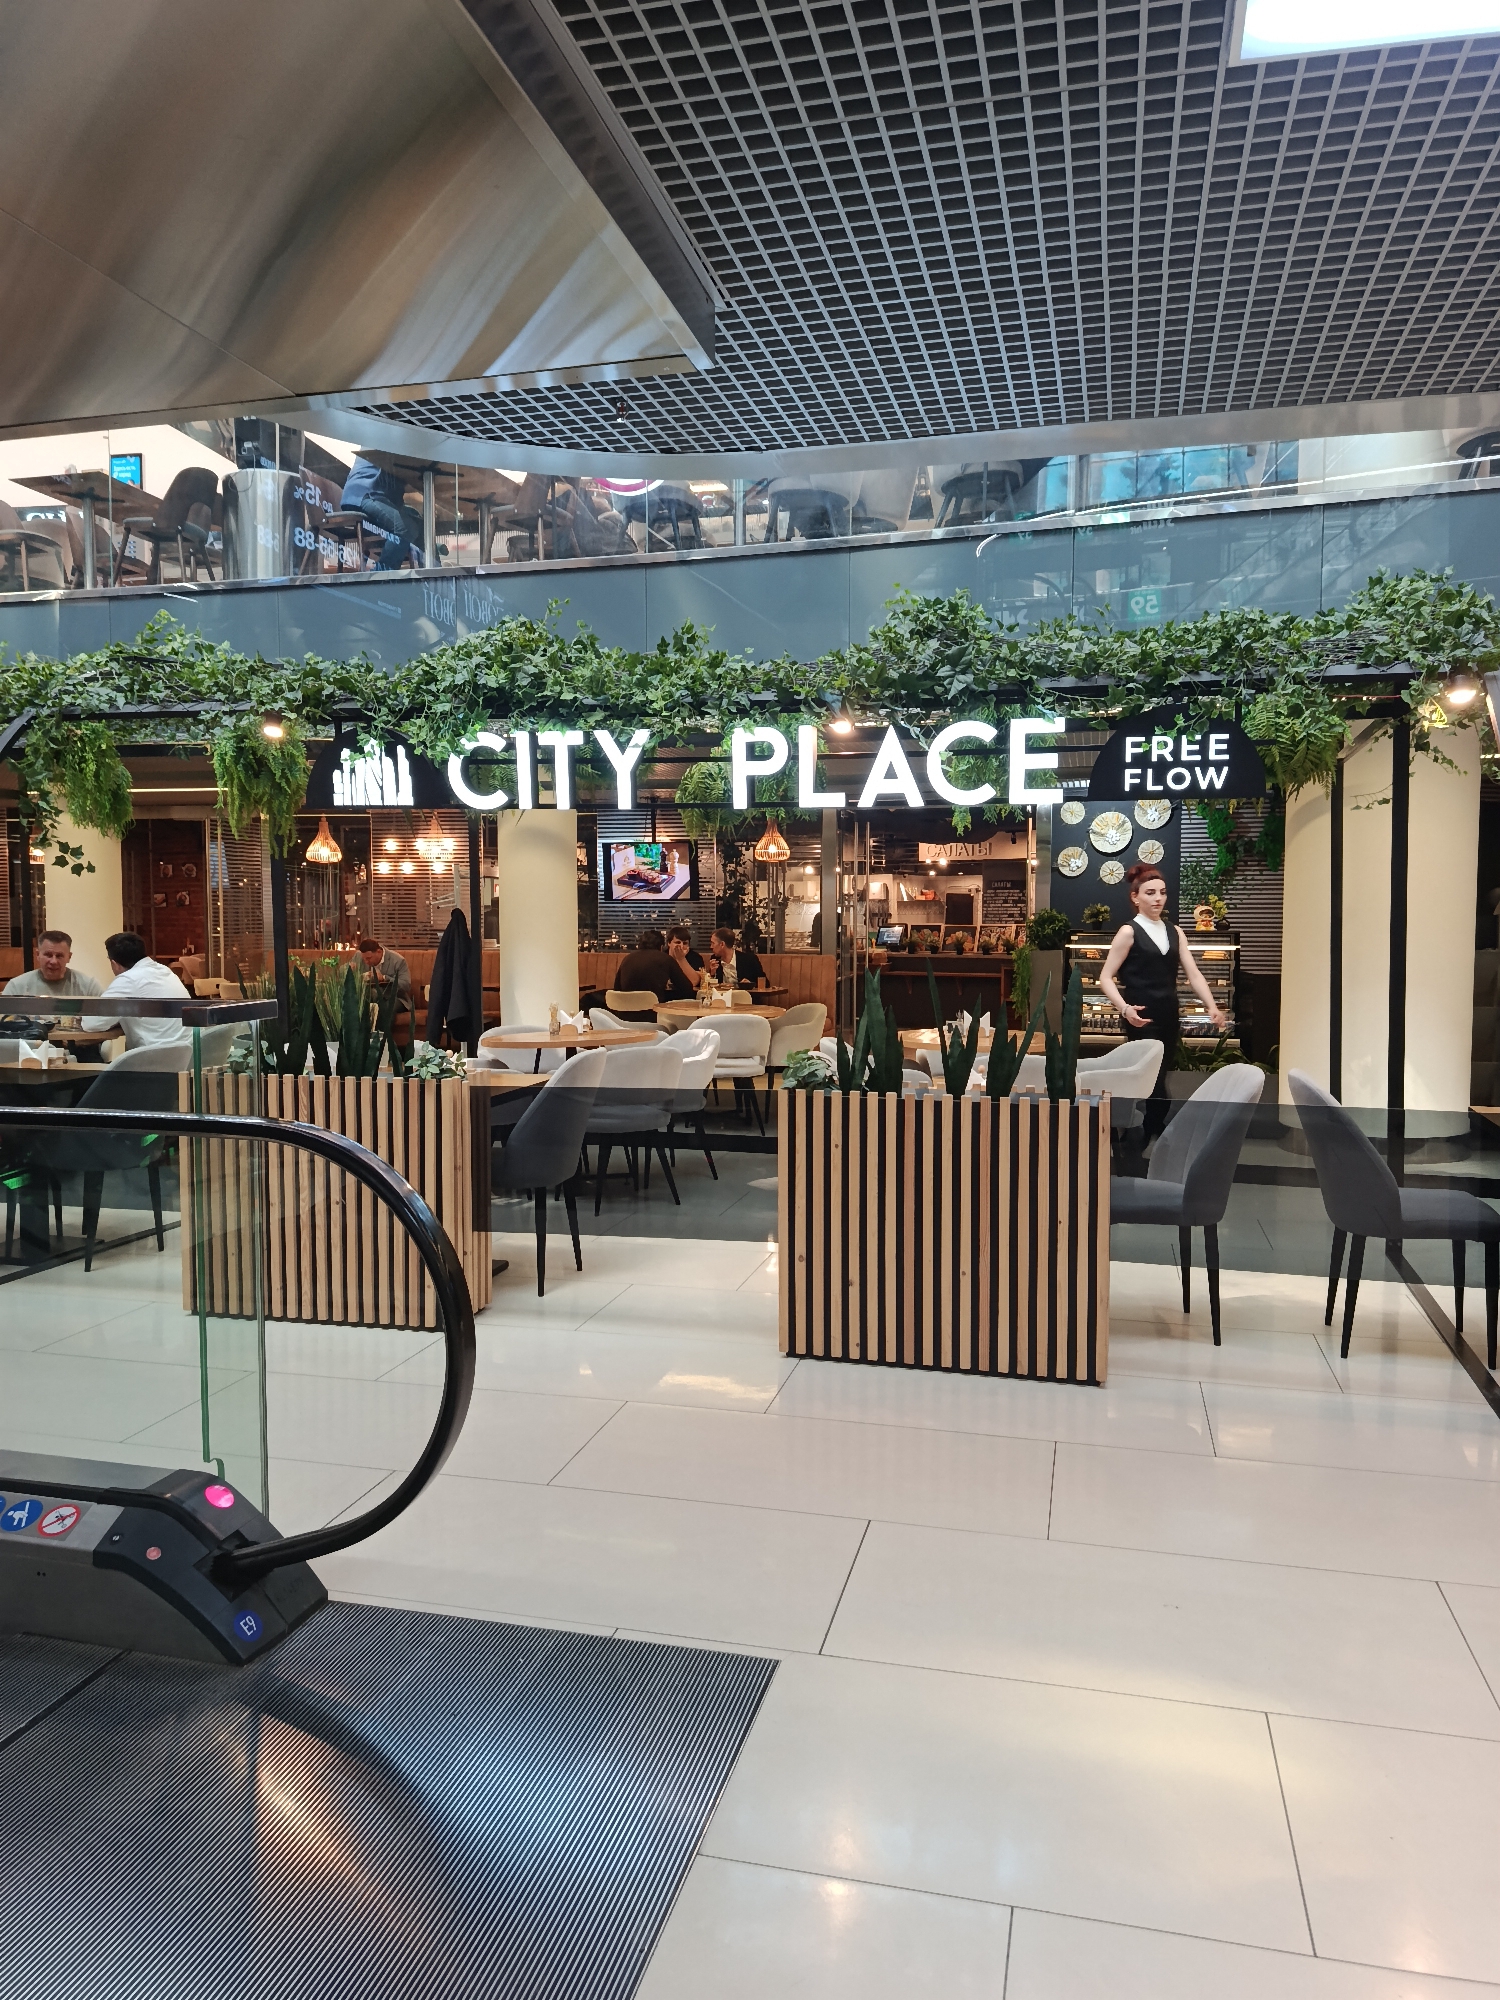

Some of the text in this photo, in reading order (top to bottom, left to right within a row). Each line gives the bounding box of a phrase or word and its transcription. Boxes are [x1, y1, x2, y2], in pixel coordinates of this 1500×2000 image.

[1125, 733, 1230, 763] FREE
[447, 717, 1065, 810] CITY PLACE
[1124, 766, 1229, 791] FLOW
[927, 841, 993, 858] САЛАТЫ
[239, 1615, 257, 1636] E9
